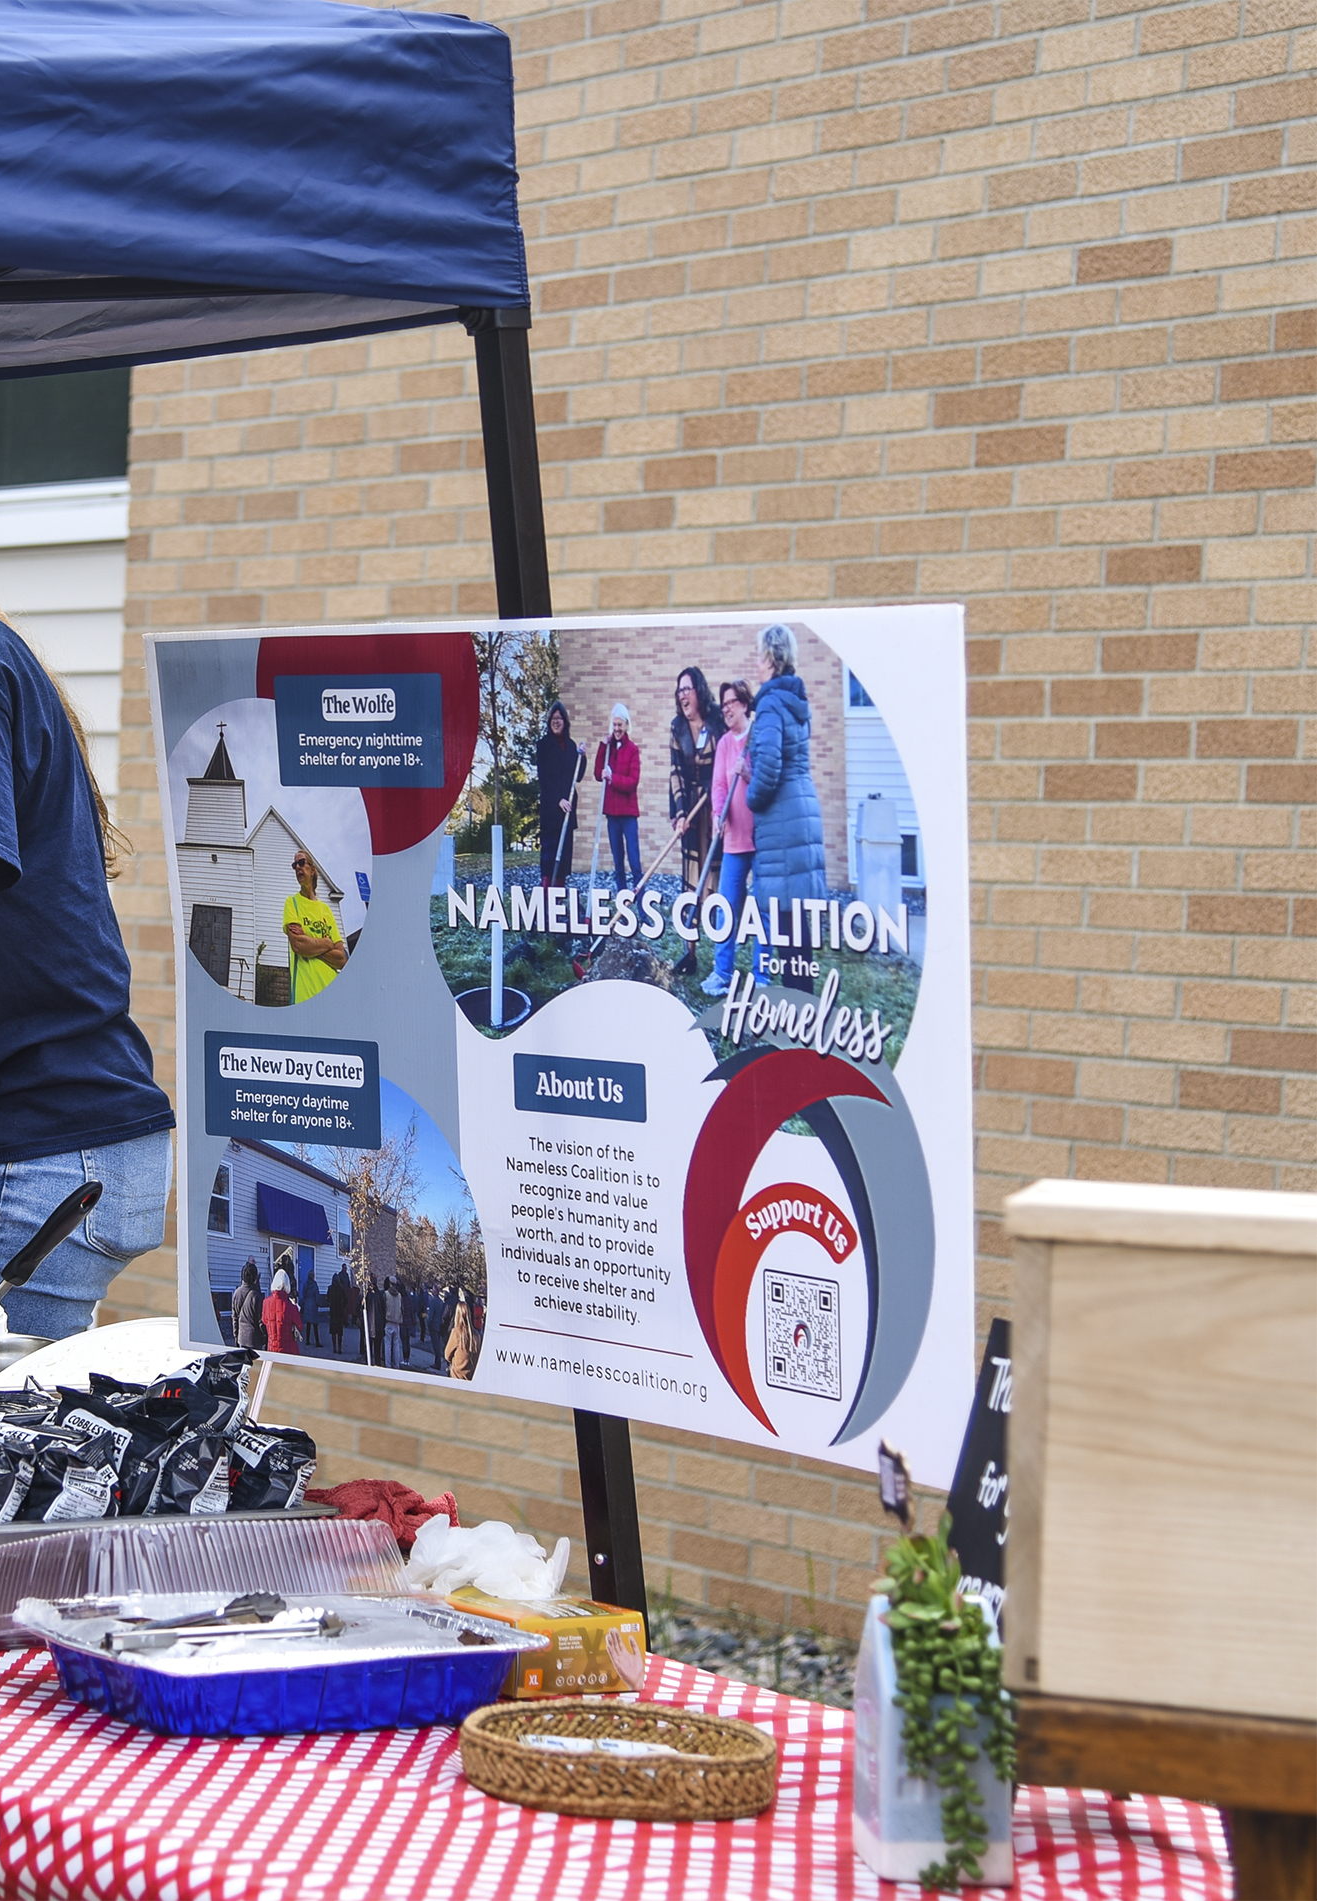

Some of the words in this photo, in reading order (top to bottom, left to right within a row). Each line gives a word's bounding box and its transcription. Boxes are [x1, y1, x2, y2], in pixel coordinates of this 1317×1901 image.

[323, 695, 350, 713] The
[352, 694, 394, 714] Wolfe
[299, 733, 363, 749] Emergency
[365, 733, 423, 750] nighttime
[299, 752, 338, 766] shelter
[341, 751, 356, 766] for
[359, 754, 401, 769] anyone
[403, 752, 424, 766] 18+.
[447, 883, 666, 940] NAMELESS
[671, 892, 910, 955] COALITION
[759, 952, 787, 975] For
[790, 954, 820, 979] the
[720, 967, 892, 1062] Homeless
[221, 1053, 247, 1072] The
[251, 1056, 282, 1075] New
[285, 1058, 313, 1081] Day
[315, 1060, 363, 1081] Center
[236, 1089, 300, 1109] Emergency
[302, 1094, 349, 1111] daytime
[536, 1070, 595, 1101] About
[597, 1077, 624, 1104] Us
[231, 1107, 270, 1122] shelter
[272, 1110, 287, 1124] for
[290, 1114, 332, 1129] anyone
[335, 1116, 355, 1130] 18+.
[529, 1136, 553, 1153] The
[556, 1140, 593, 1157] vision
[596, 1144, 610, 1160] of
[613, 1146, 635, 1162] the
[506, 1157, 568, 1177] Nameless
[571, 1164, 629, 1185] Coalition
[633, 1170, 643, 1186] is
[647, 1173, 660, 1188] to
[519, 1181, 582, 1202] recognize
[585, 1186, 609, 1205] and
[613, 1192, 648, 1210] value
[511, 1204, 564, 1222] people's
[567, 1207, 630, 1234] humanity
[633, 1217, 658, 1234] and
[745, 1198, 823, 1241] Support
[823, 1211, 849, 1255] Us
[515, 1226, 557, 1245] worth,
[560, 1230, 584, 1247] and
[588, 1234, 602, 1249] to
[606, 1237, 654, 1257] provide
[501, 1243, 571, 1267] individuals
[574, 1255, 590, 1270] an
[593, 1258, 672, 1286] opportunity
[517, 1269, 531, 1283] to
[534, 1272, 579, 1291] receive
[583, 1278, 627, 1299] shelter
[630, 1284, 655, 1303] and
[534, 1294, 583, 1314] achieve
[585, 1301, 641, 1326] stability.
[495, 1348, 708, 1403] www.namelesscoalition.org
[977, 1460, 1008, 1509] for
[528, 1674, 539, 1686] XL
